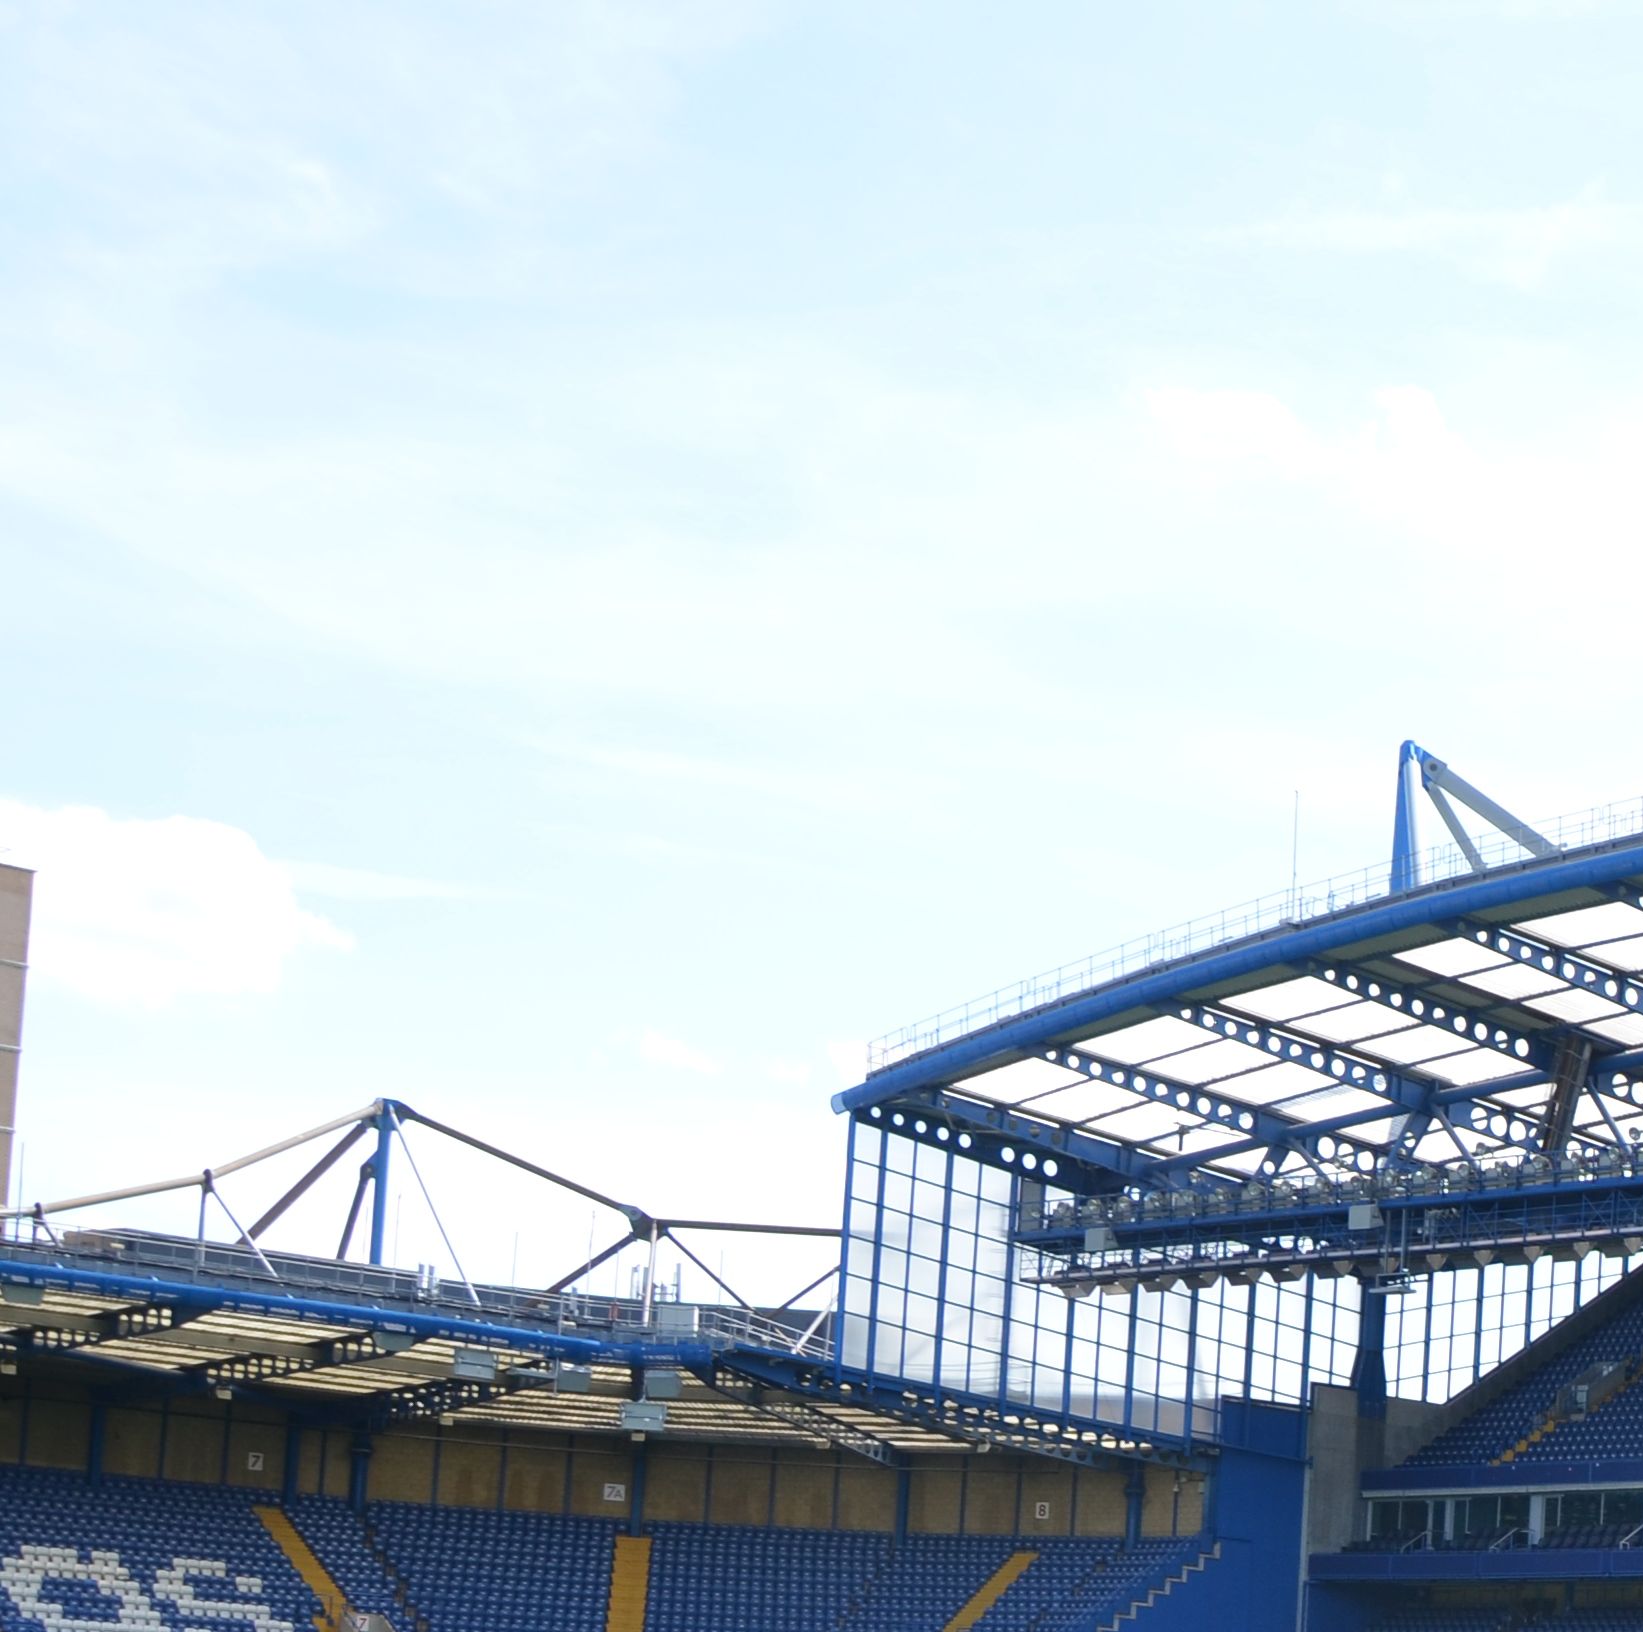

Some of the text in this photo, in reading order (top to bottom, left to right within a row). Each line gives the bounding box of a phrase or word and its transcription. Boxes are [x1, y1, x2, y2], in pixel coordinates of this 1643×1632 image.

[251, 1455, 260, 1468] 7
[1037, 1504, 1046, 1517] 8
[358, 1618, 367, 1631] 7
